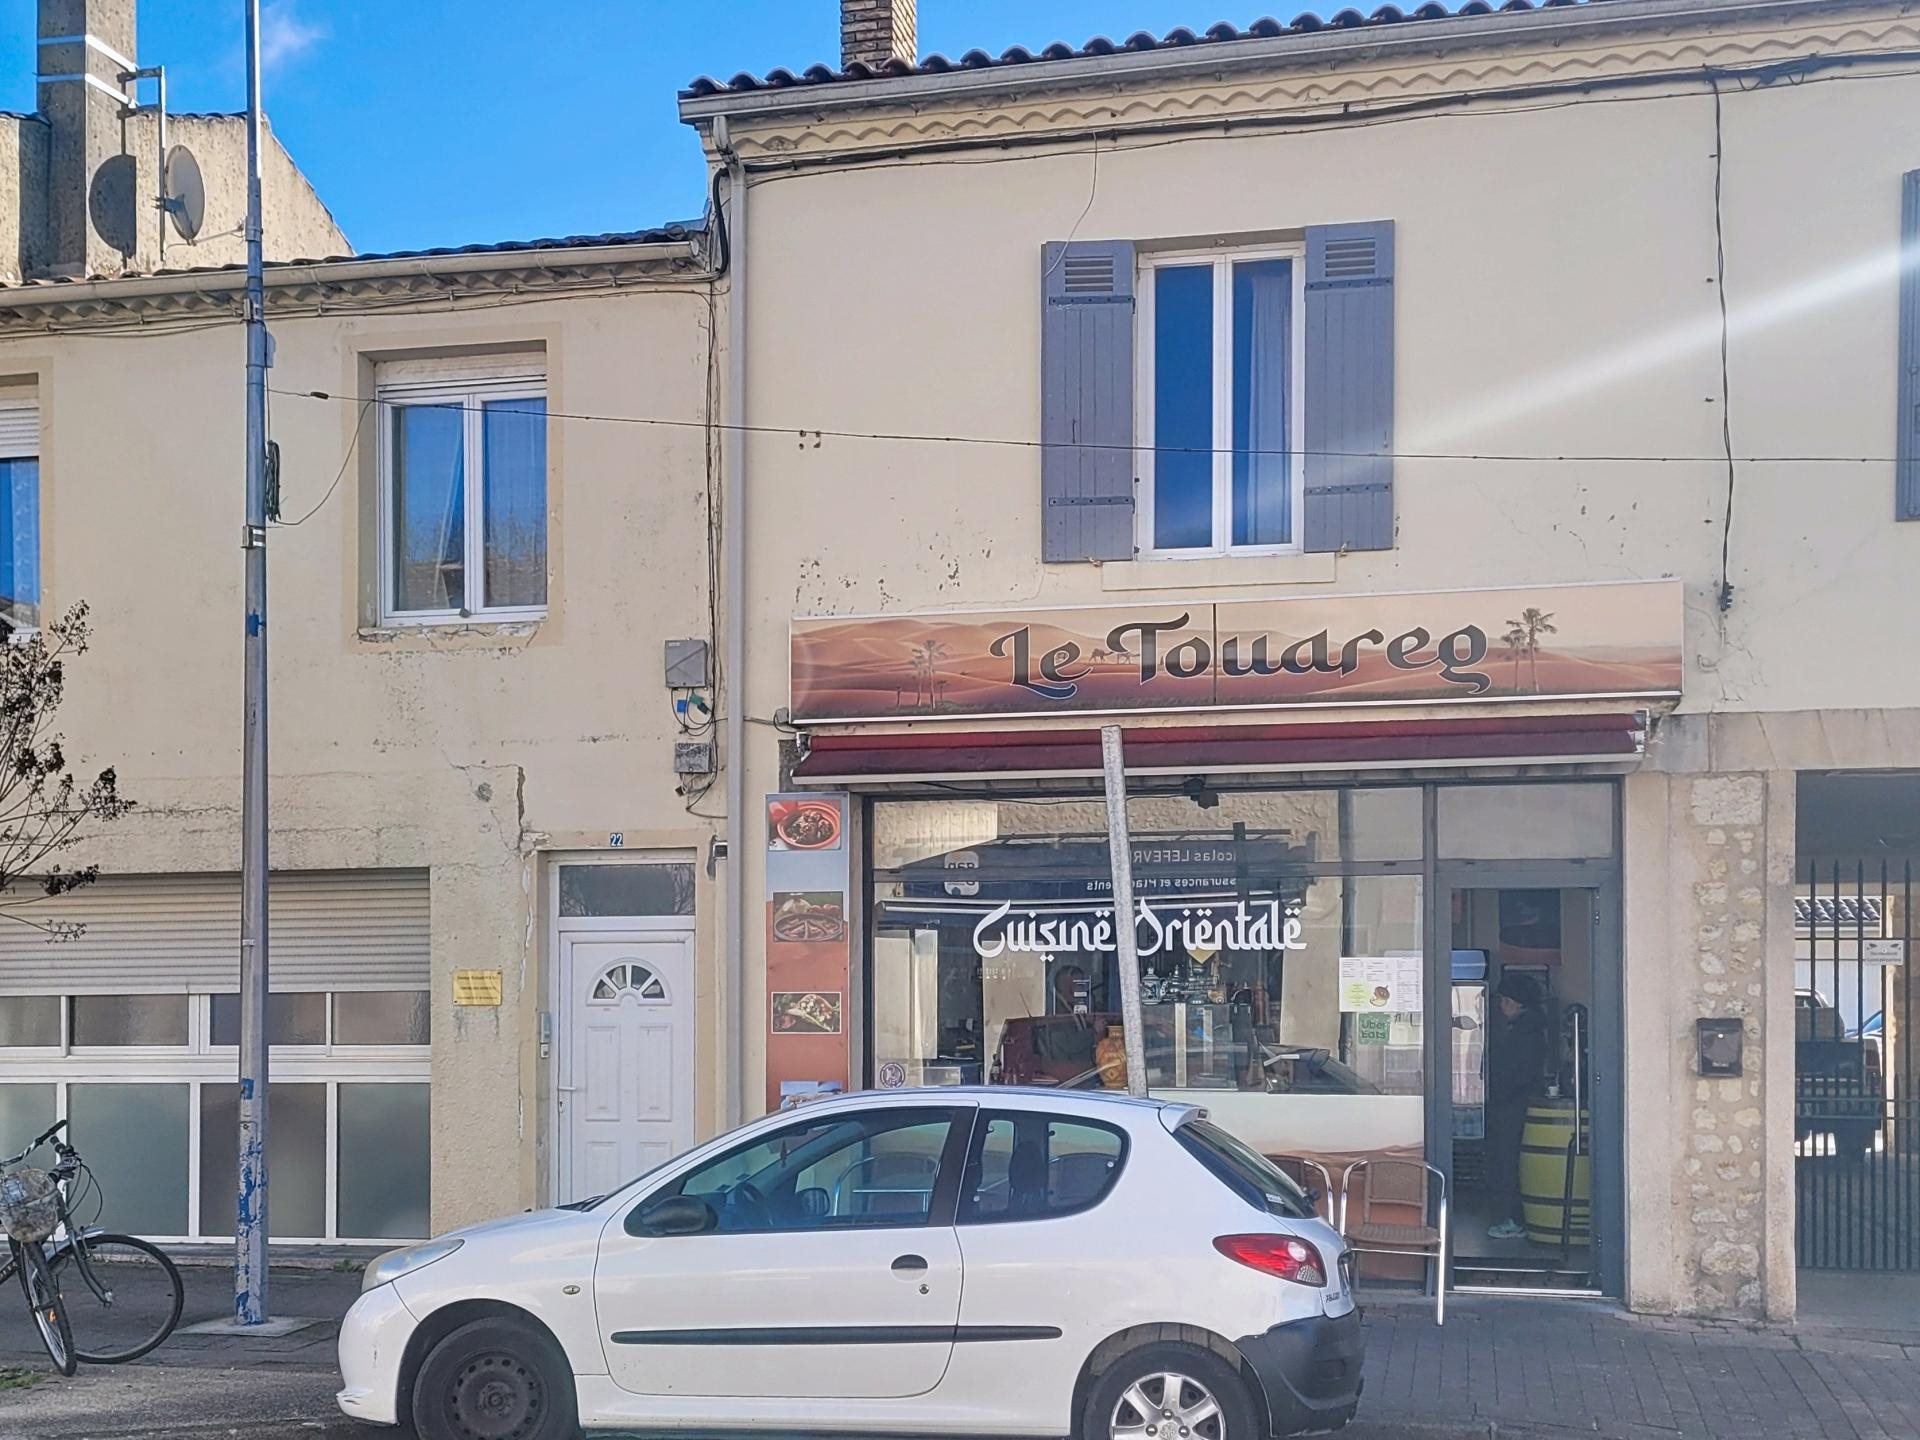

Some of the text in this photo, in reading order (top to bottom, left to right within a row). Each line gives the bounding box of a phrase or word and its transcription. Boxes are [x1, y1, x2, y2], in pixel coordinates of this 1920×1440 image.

[989, 612, 1491, 699] Le Touareg
[610, 833, 623, 847] 22
[1361, 1019, 1389, 1030] Uber
[1361, 1030, 1386, 1039] Eats
